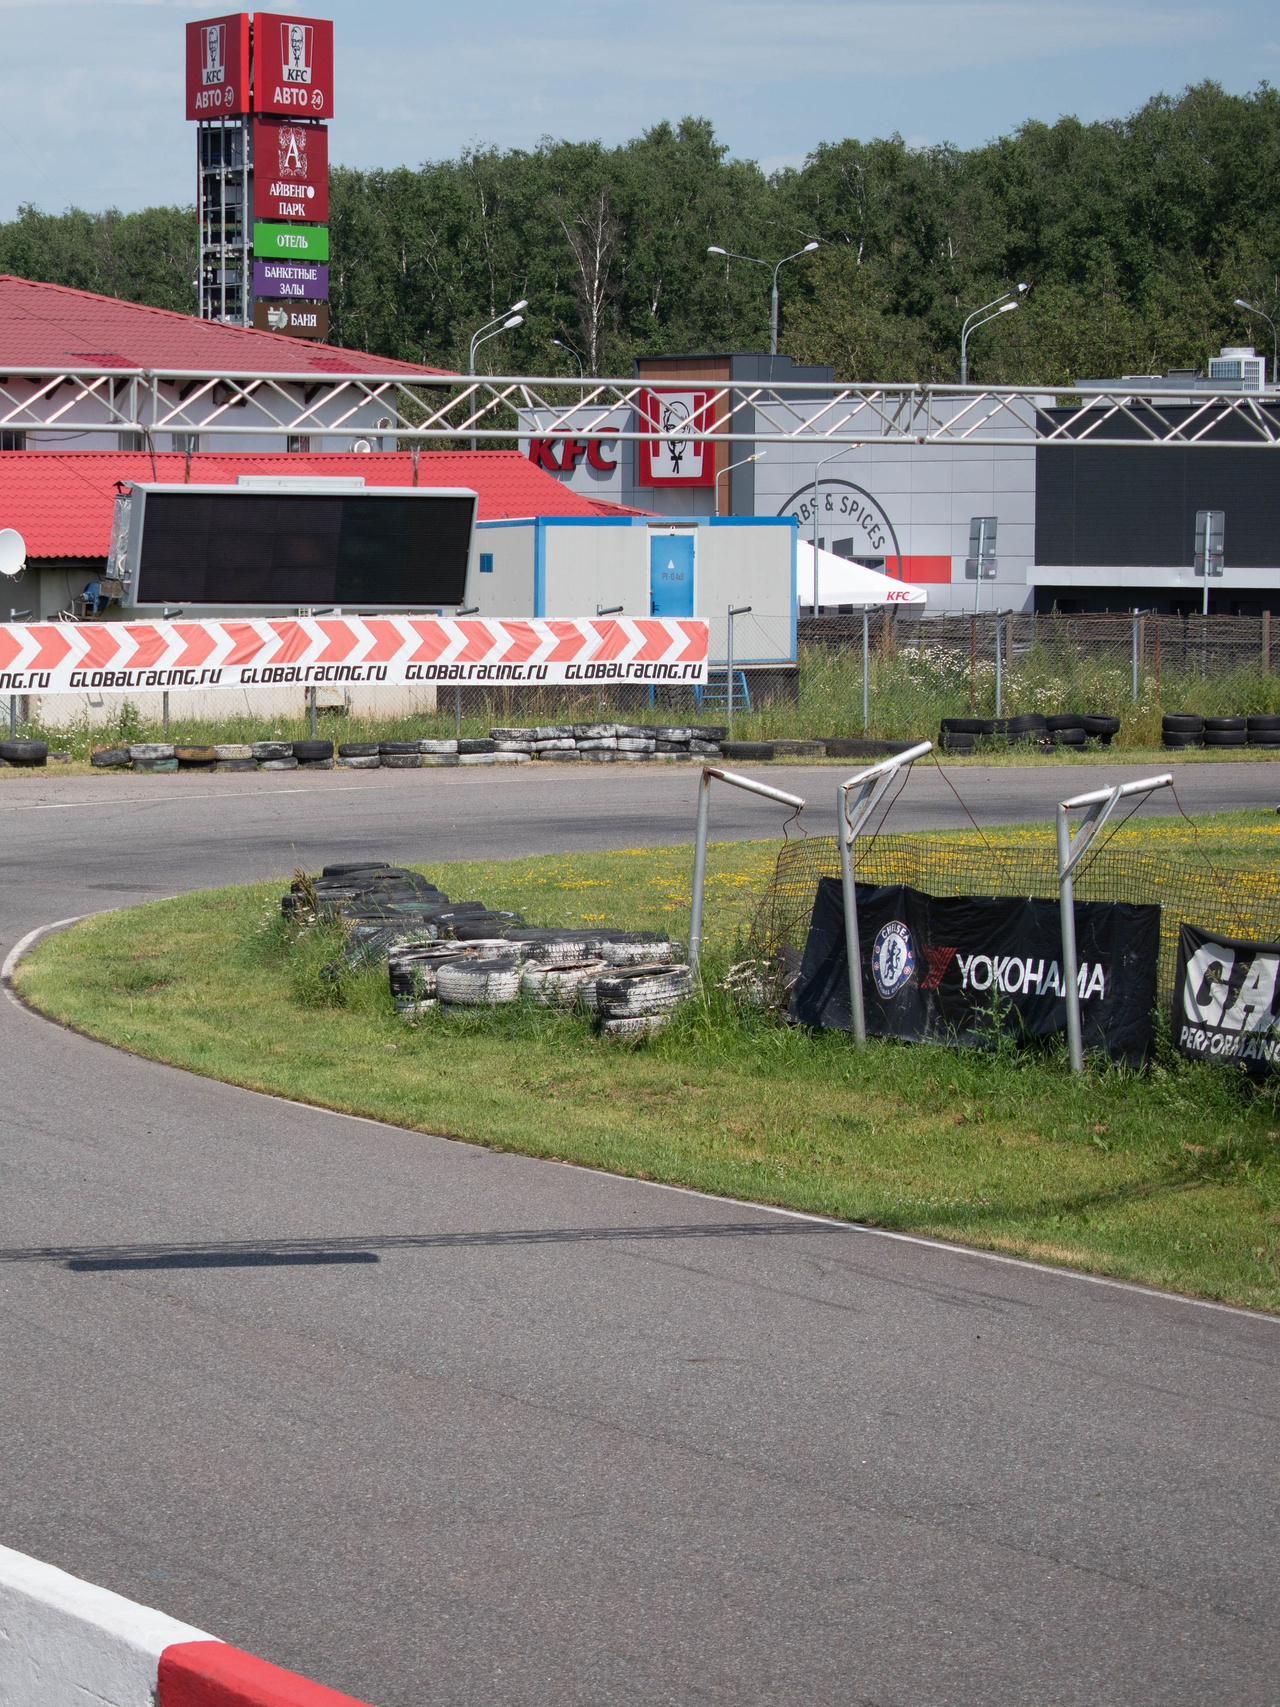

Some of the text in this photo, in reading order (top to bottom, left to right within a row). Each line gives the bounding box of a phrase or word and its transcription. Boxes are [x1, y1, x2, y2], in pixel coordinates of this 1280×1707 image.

[205, 69, 221, 83] KFC
[287, 69, 307, 82] KFC
[195, 89, 221, 109] АВТО
[274, 87, 308, 106] АВТО
[269, 181, 315, 199] АЙВЕНГО
[279, 202, 305, 216] ПАРК
[276, 234, 308, 249] ОТЕЛЬ
[264, 266, 317, 281] БАНКЕТНЫЕ
[279, 283, 305, 296] ЗАЛЫ
[291, 313, 317, 327] БАНЯ
[529, 427, 620, 470] KFC
[825, 493, 834, 511] &
[840, 495, 885, 550] SPICES
[886, 591, 910, 601] KFC
[881, 923, 910, 943] CHELSEA
[955, 953, 1105, 1000] YOKOHAMA
[1183, 942, 1280, 1032] GA
